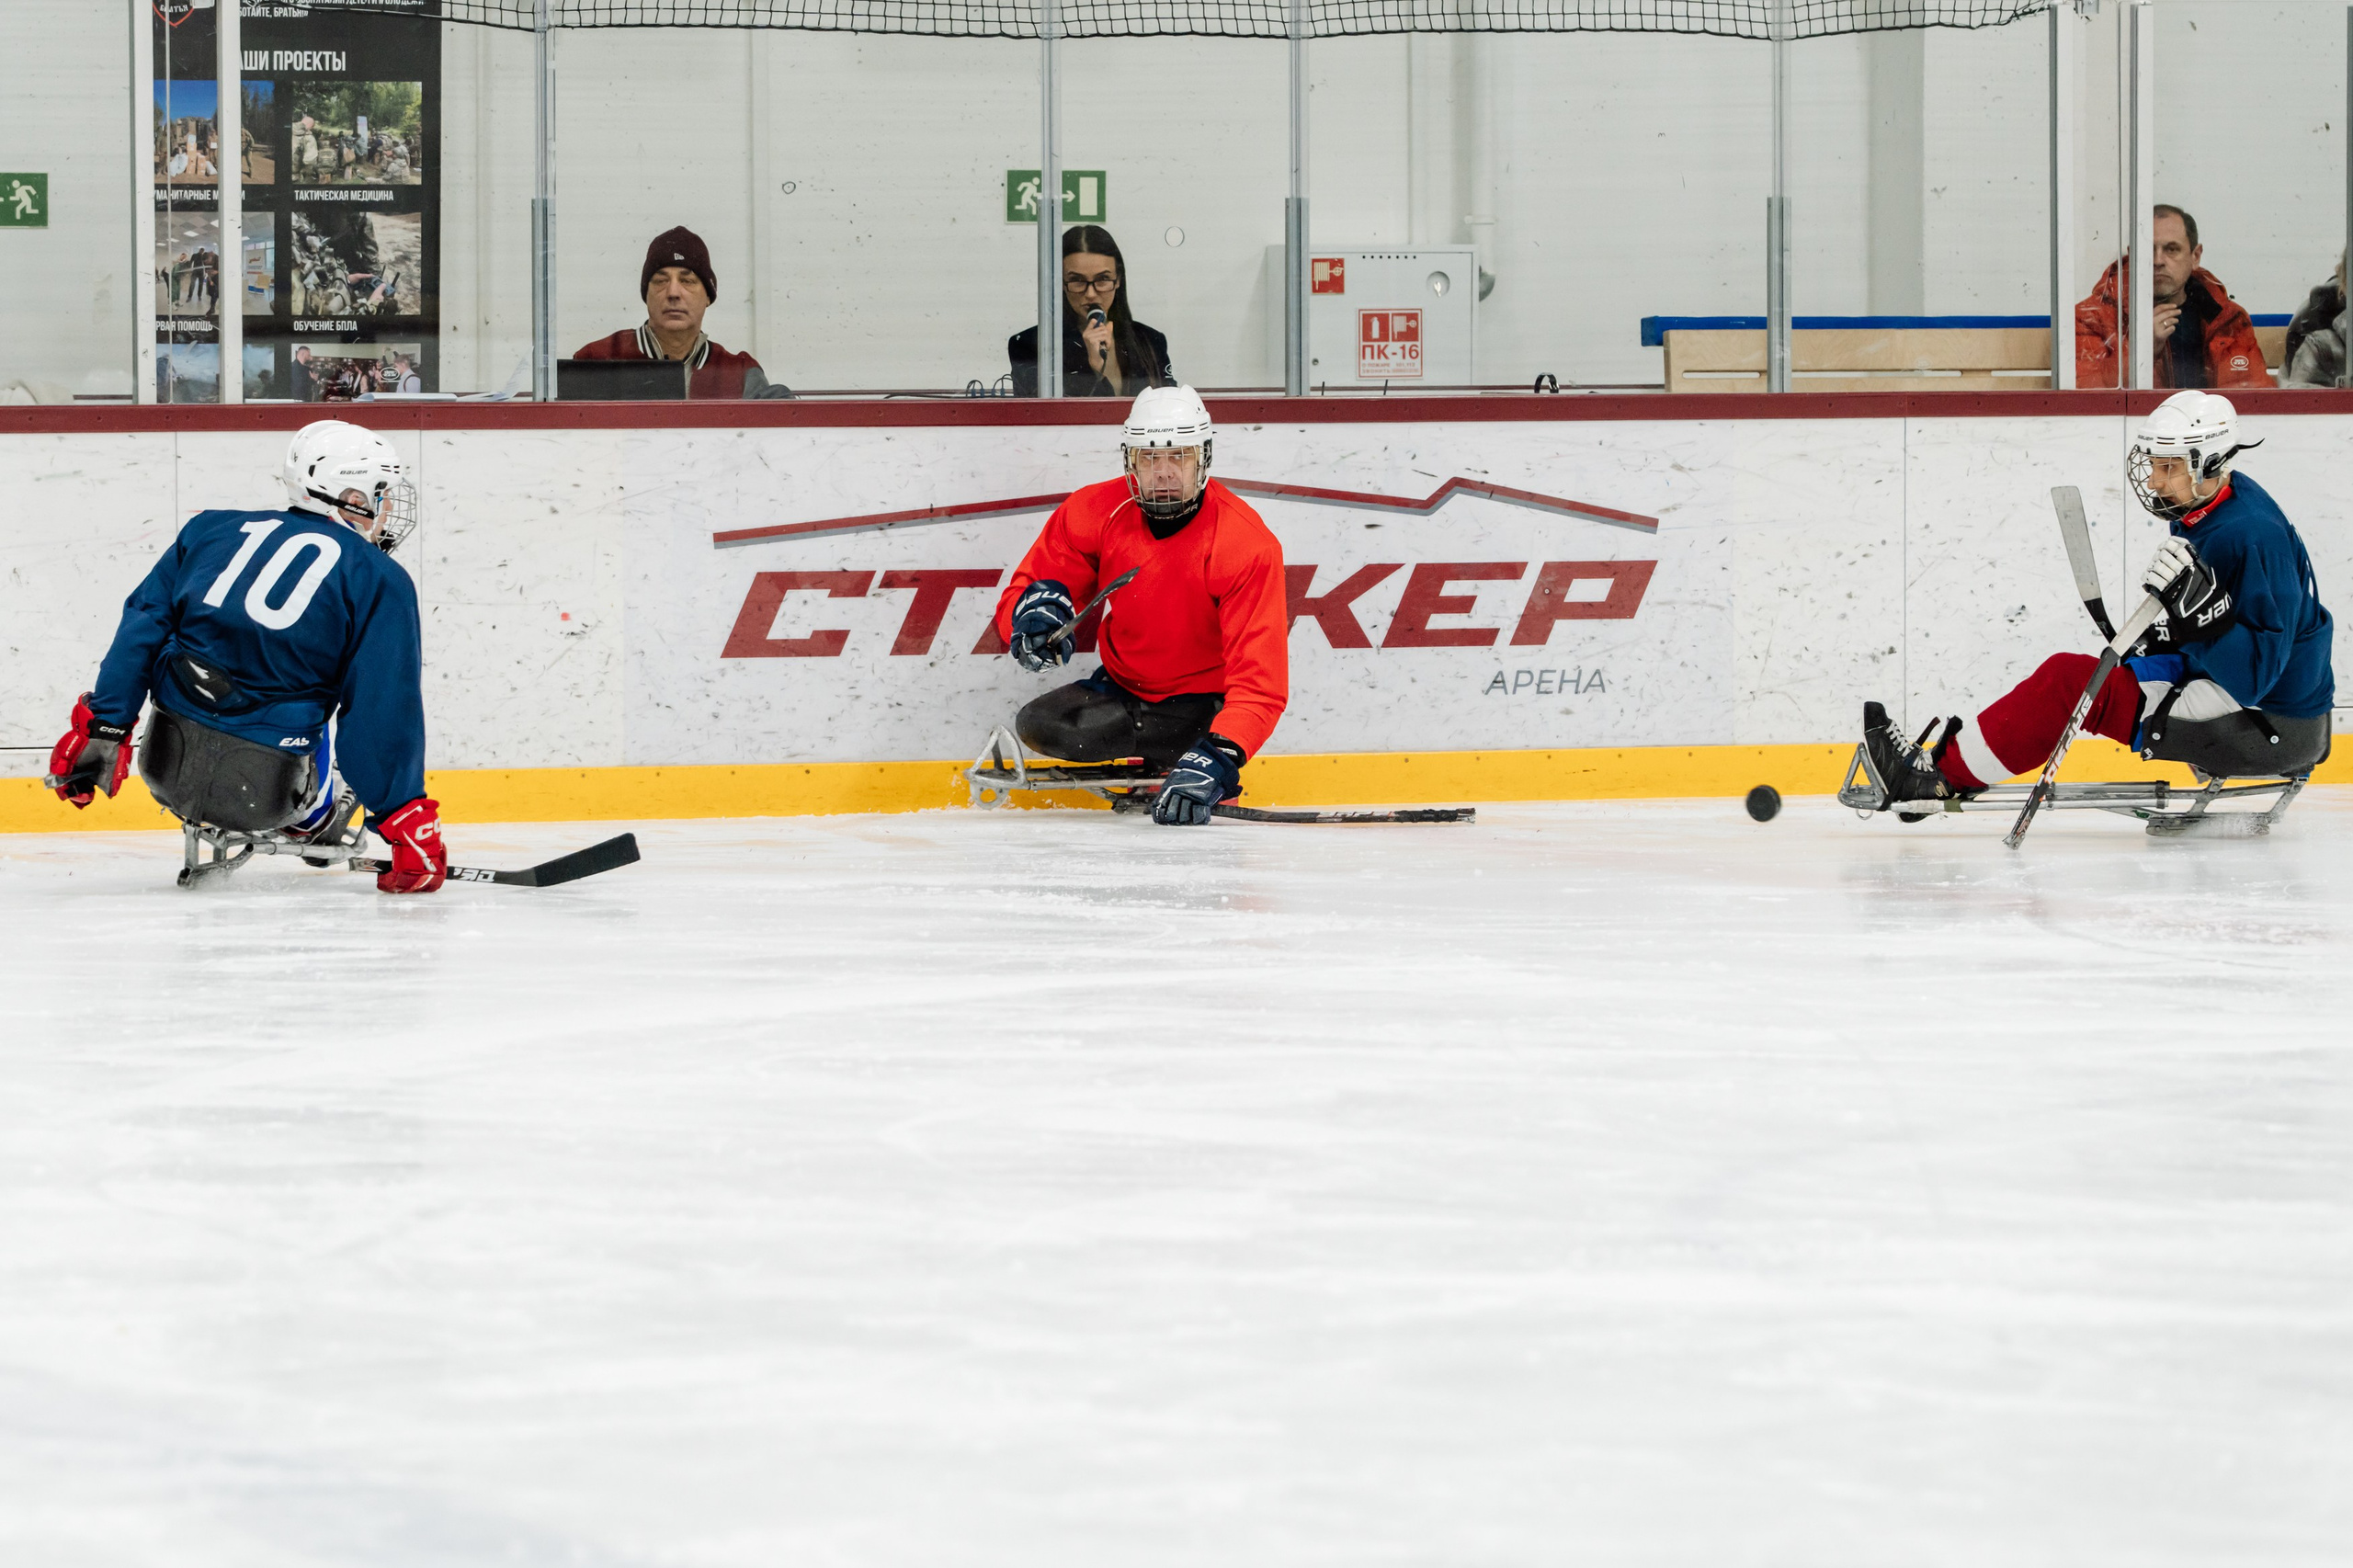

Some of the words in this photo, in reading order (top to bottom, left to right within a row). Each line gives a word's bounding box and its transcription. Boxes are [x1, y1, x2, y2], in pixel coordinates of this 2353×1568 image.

[273, 50, 347, 72] ПРОЕКТЫ
[294, 189, 349, 201] ТАКТИЧЕСКАЯ
[350, 189, 394, 202] МЕДИЦИНА
[177, 320, 213, 333] ПОМОЩЬ
[293, 320, 335, 332] ОБУЧЕНИЕ
[335, 320, 358, 332] БПЛА
[1362, 344, 1419, 360] ПК-16
[2205, 428, 2230, 440] BAUER
[344, 504, 369, 516] BAUER
[202, 518, 343, 631] 10
[720, 560, 1659, 659] СТКЕР
[1483, 667, 1607, 697] АРЕНА
[98, 725, 127, 736] CCM
